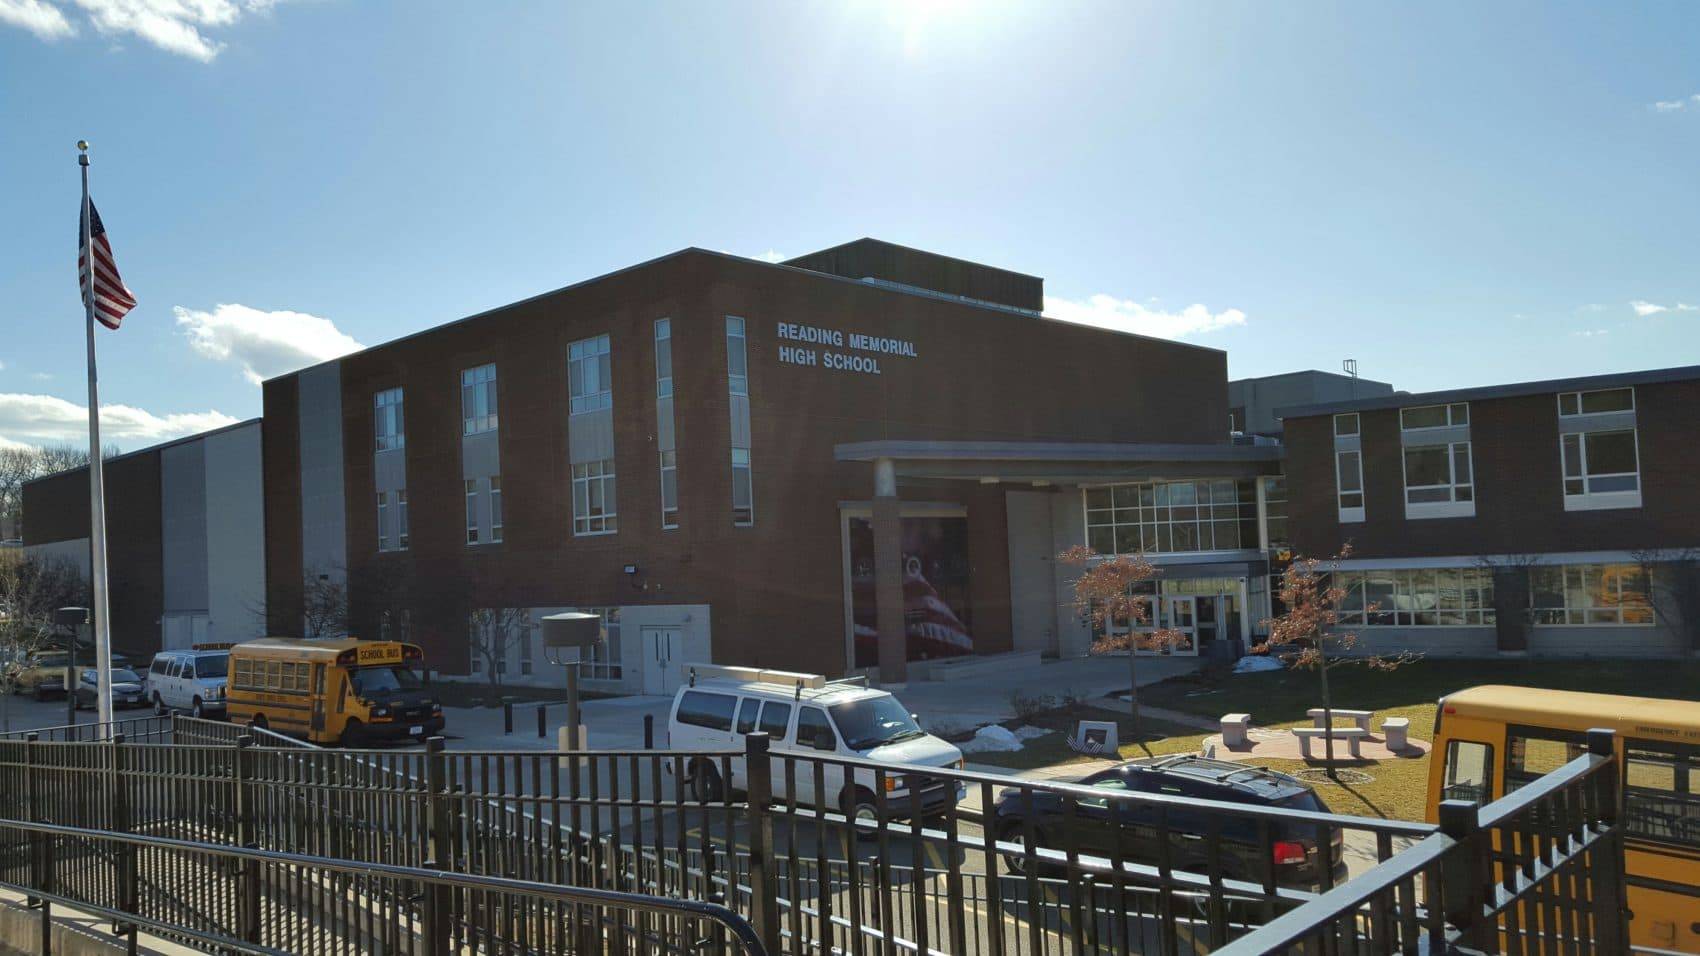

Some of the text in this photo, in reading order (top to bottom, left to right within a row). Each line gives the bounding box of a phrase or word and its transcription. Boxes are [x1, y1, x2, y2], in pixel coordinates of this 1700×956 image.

[778, 322, 918, 357] READING MEMORIAL
[778, 346, 881, 374] HIGH SCHOOL
[361, 648, 399, 660] SCHOOL BUS
